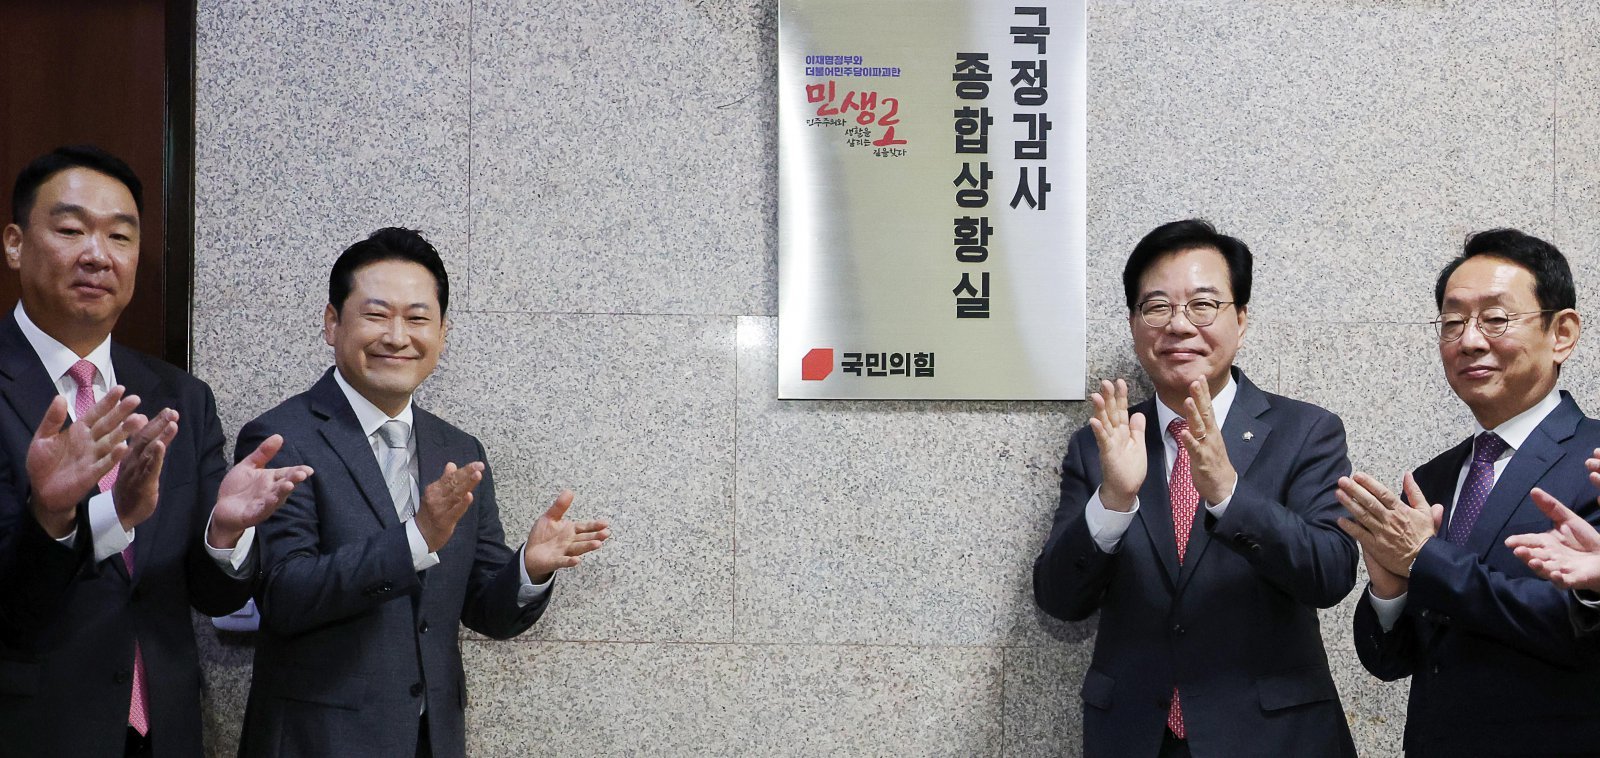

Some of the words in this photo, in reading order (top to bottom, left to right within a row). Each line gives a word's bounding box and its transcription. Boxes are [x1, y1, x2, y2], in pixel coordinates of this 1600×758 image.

[805, 55, 863, 65] 이재명정부와
[1010, 6, 1052, 211] 국정감사
[952, 52, 994, 319] 종합상황실
[841, 352, 935, 378] 국민의힘
